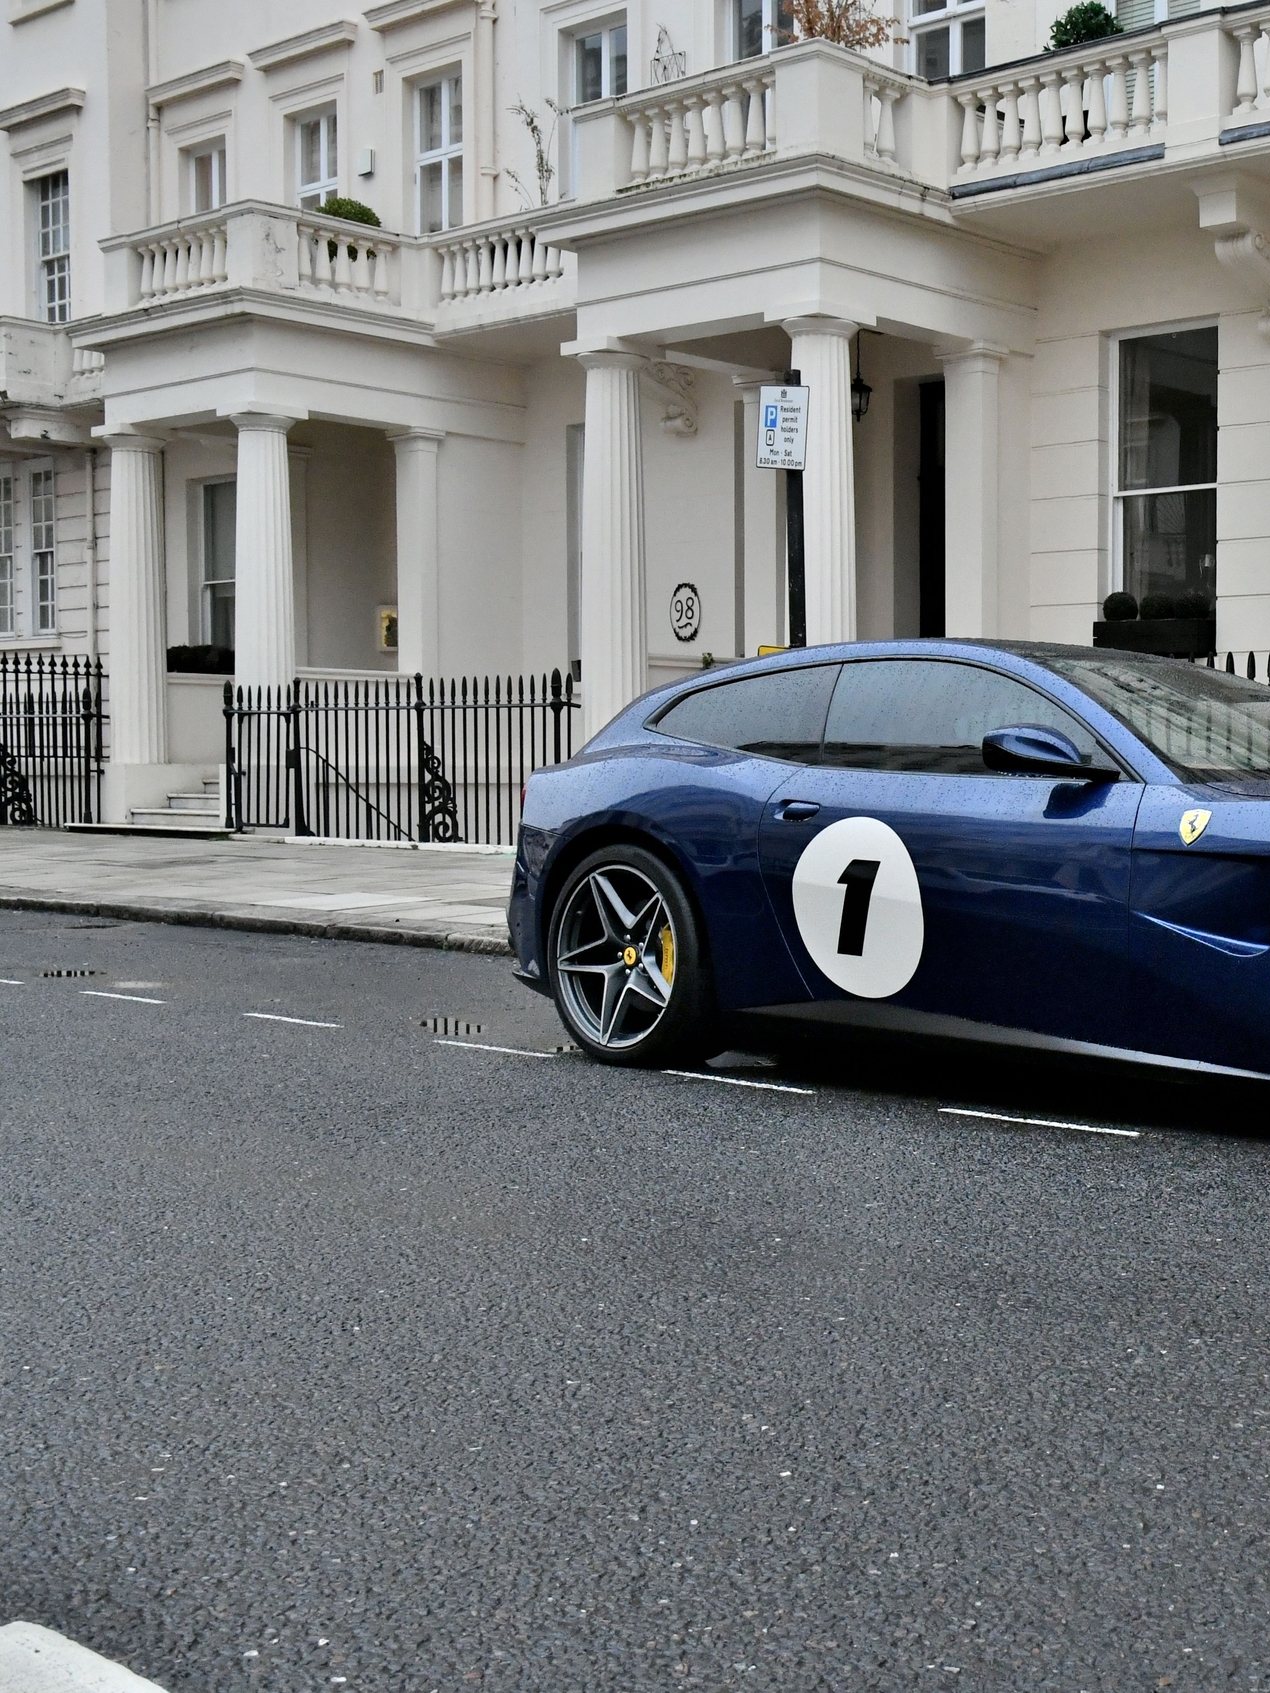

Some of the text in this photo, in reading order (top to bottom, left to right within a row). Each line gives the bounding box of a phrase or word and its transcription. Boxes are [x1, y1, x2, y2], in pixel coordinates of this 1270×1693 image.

[780, 405, 801, 413] Resident
[766, 407, 776, 426] P
[780, 426, 799, 434] holders
[784, 436, 794, 444] only
[769, 448, 780, 456] Mon
[784, 449, 793, 457] Sat
[675, 597, 694, 622] 98
[837, 859, 881, 956] 1
